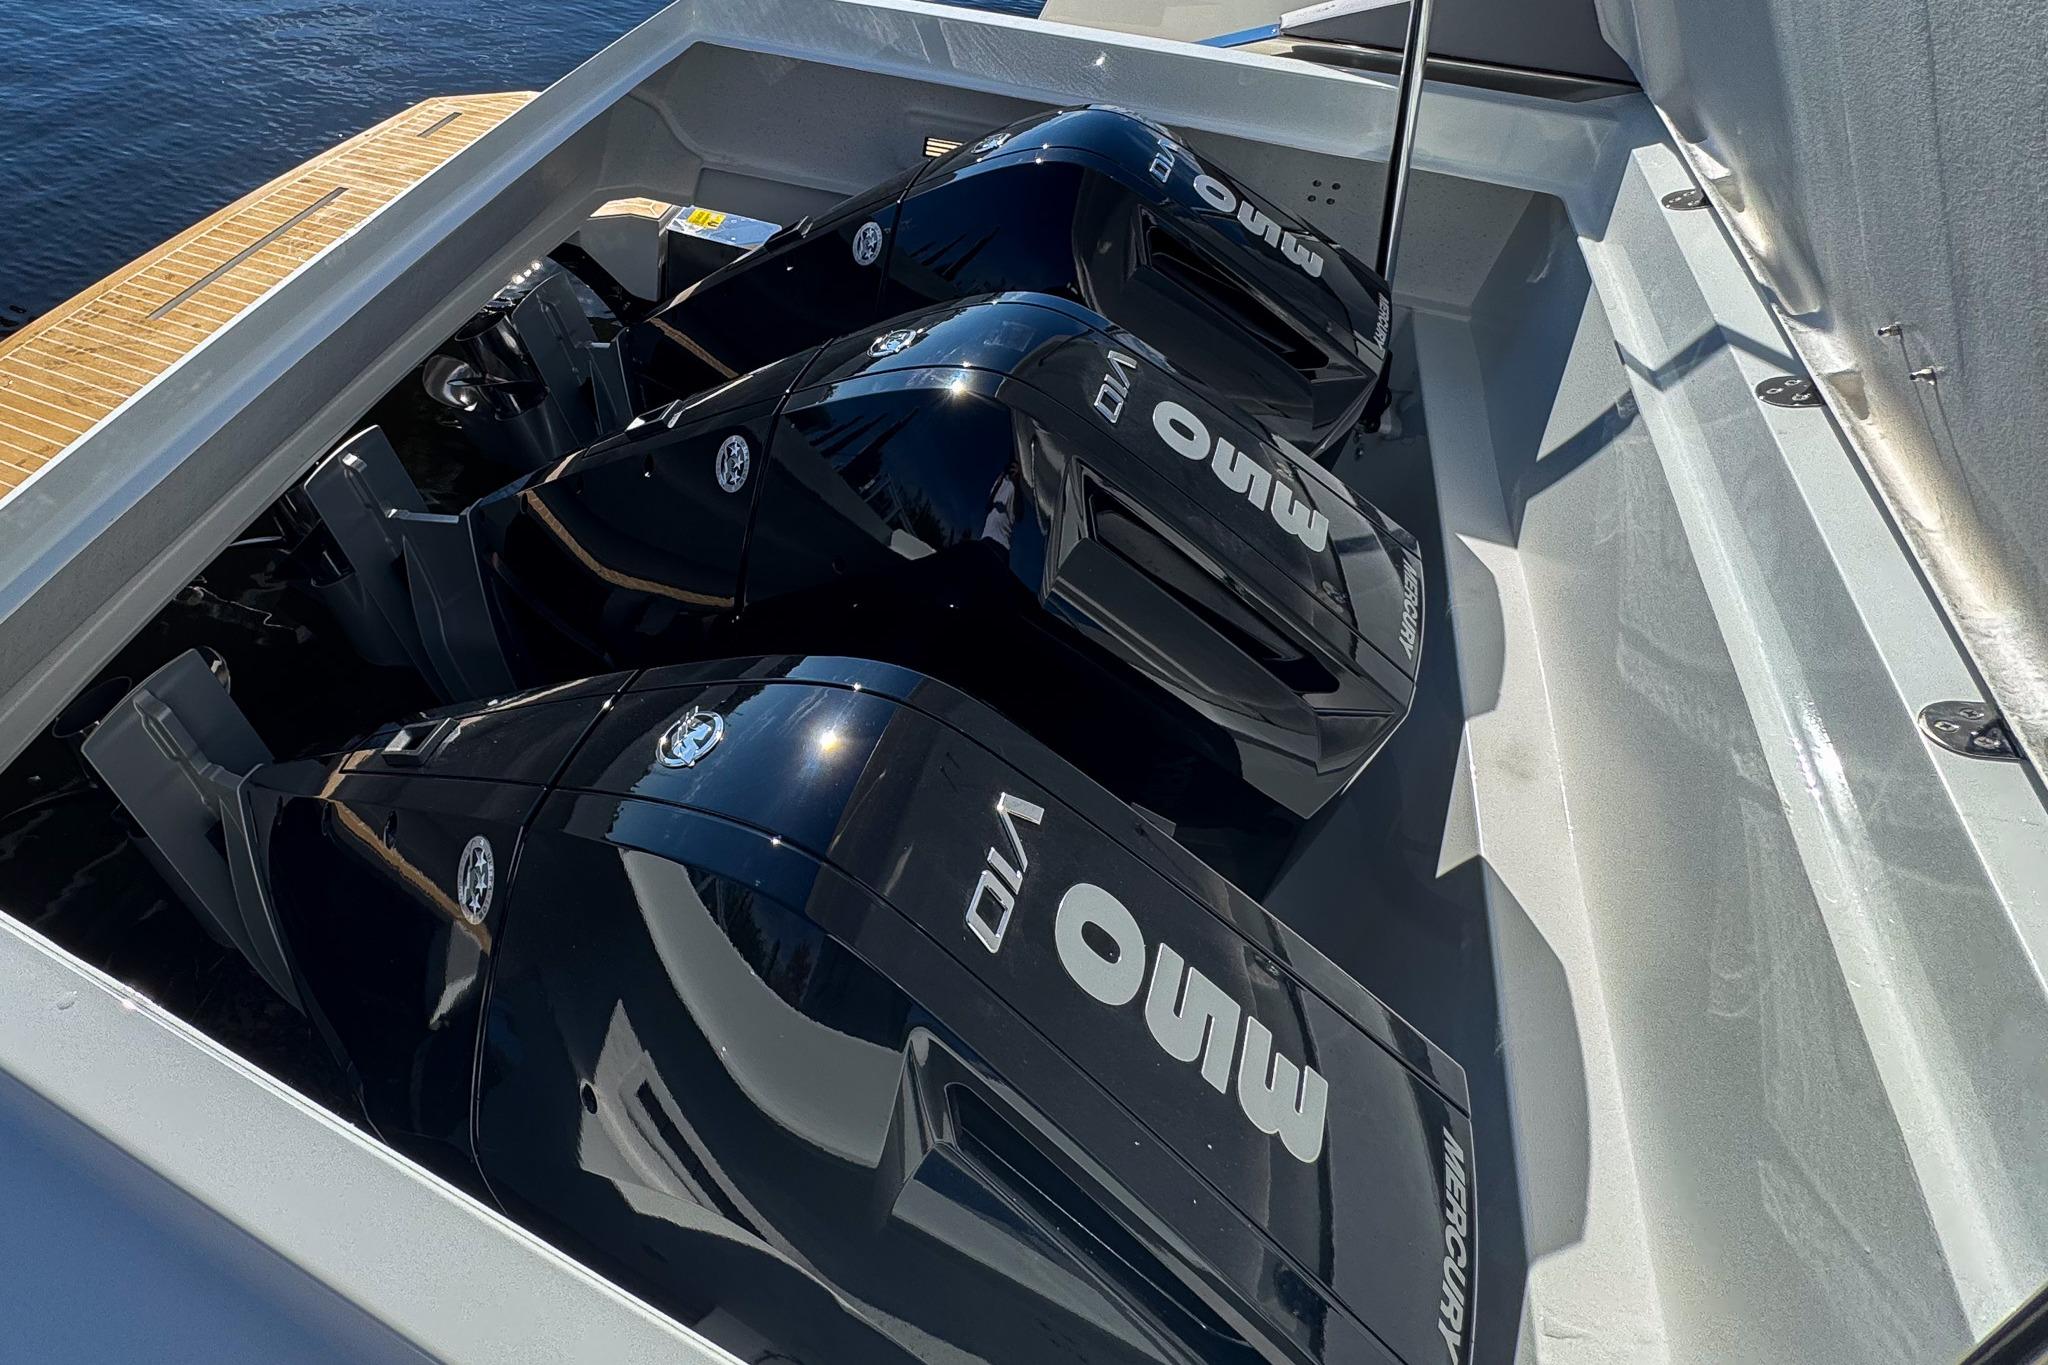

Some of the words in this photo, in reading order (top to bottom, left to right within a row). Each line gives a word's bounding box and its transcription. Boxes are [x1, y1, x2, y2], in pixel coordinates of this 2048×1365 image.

[1150, 138, 1178, 183] V10
[1373, 291, 1390, 350] MERCURY
[1094, 350, 1138, 424] V10
[1399, 558, 1418, 660] MERCURY
[965, 792, 1045, 954] V10
[1438, 1126, 1467, 1365] MERCURY
